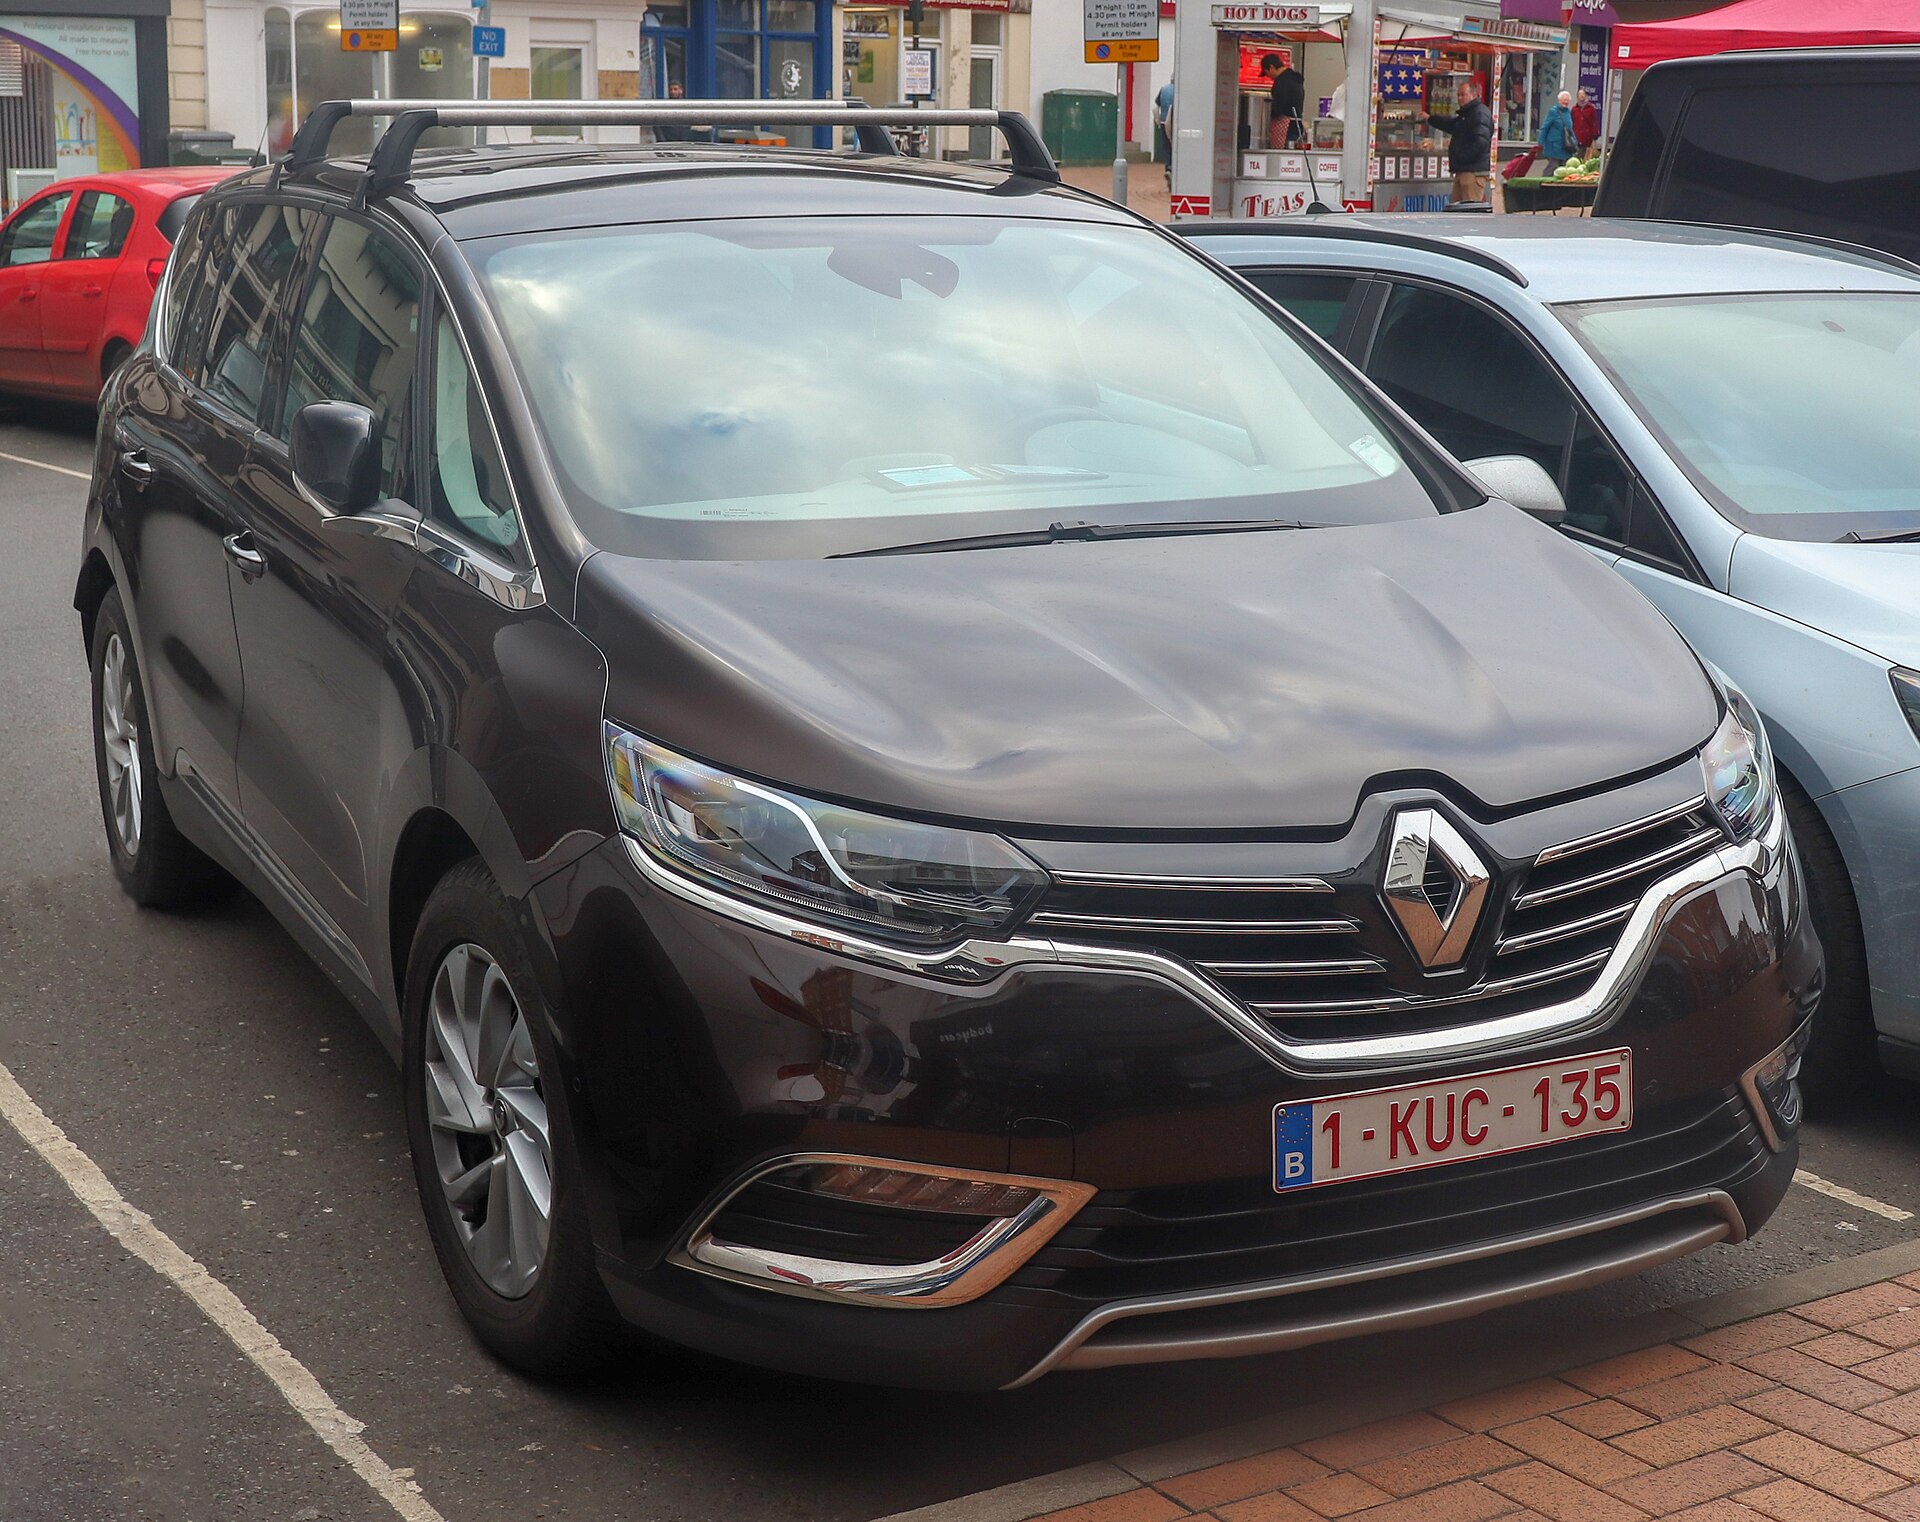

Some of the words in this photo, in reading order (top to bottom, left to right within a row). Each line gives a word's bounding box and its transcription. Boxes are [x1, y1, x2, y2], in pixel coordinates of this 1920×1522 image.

[1223, 6, 1258, 20] HOT
[1262, 7, 1308, 21] DOGS
[106, 24, 129, 32] service
[1120, 20, 1147, 28] holders
[58, 35, 67, 43] All
[70, 35, 89, 43] made
[482, 31, 496, 41] NO
[479, 41, 499, 52] EXIT
[75, 48, 90, 56] Free
[92, 48, 112, 56] home
[113, 49, 129, 57] visits
[1249, 161, 1260, 170] TEA
[1319, 163, 1338, 172] COFFEE
[1241, 191, 1305, 218] TEAS
[1404, 194, 1425, 213] HOT
[1284, 1151, 1306, 1179] B
